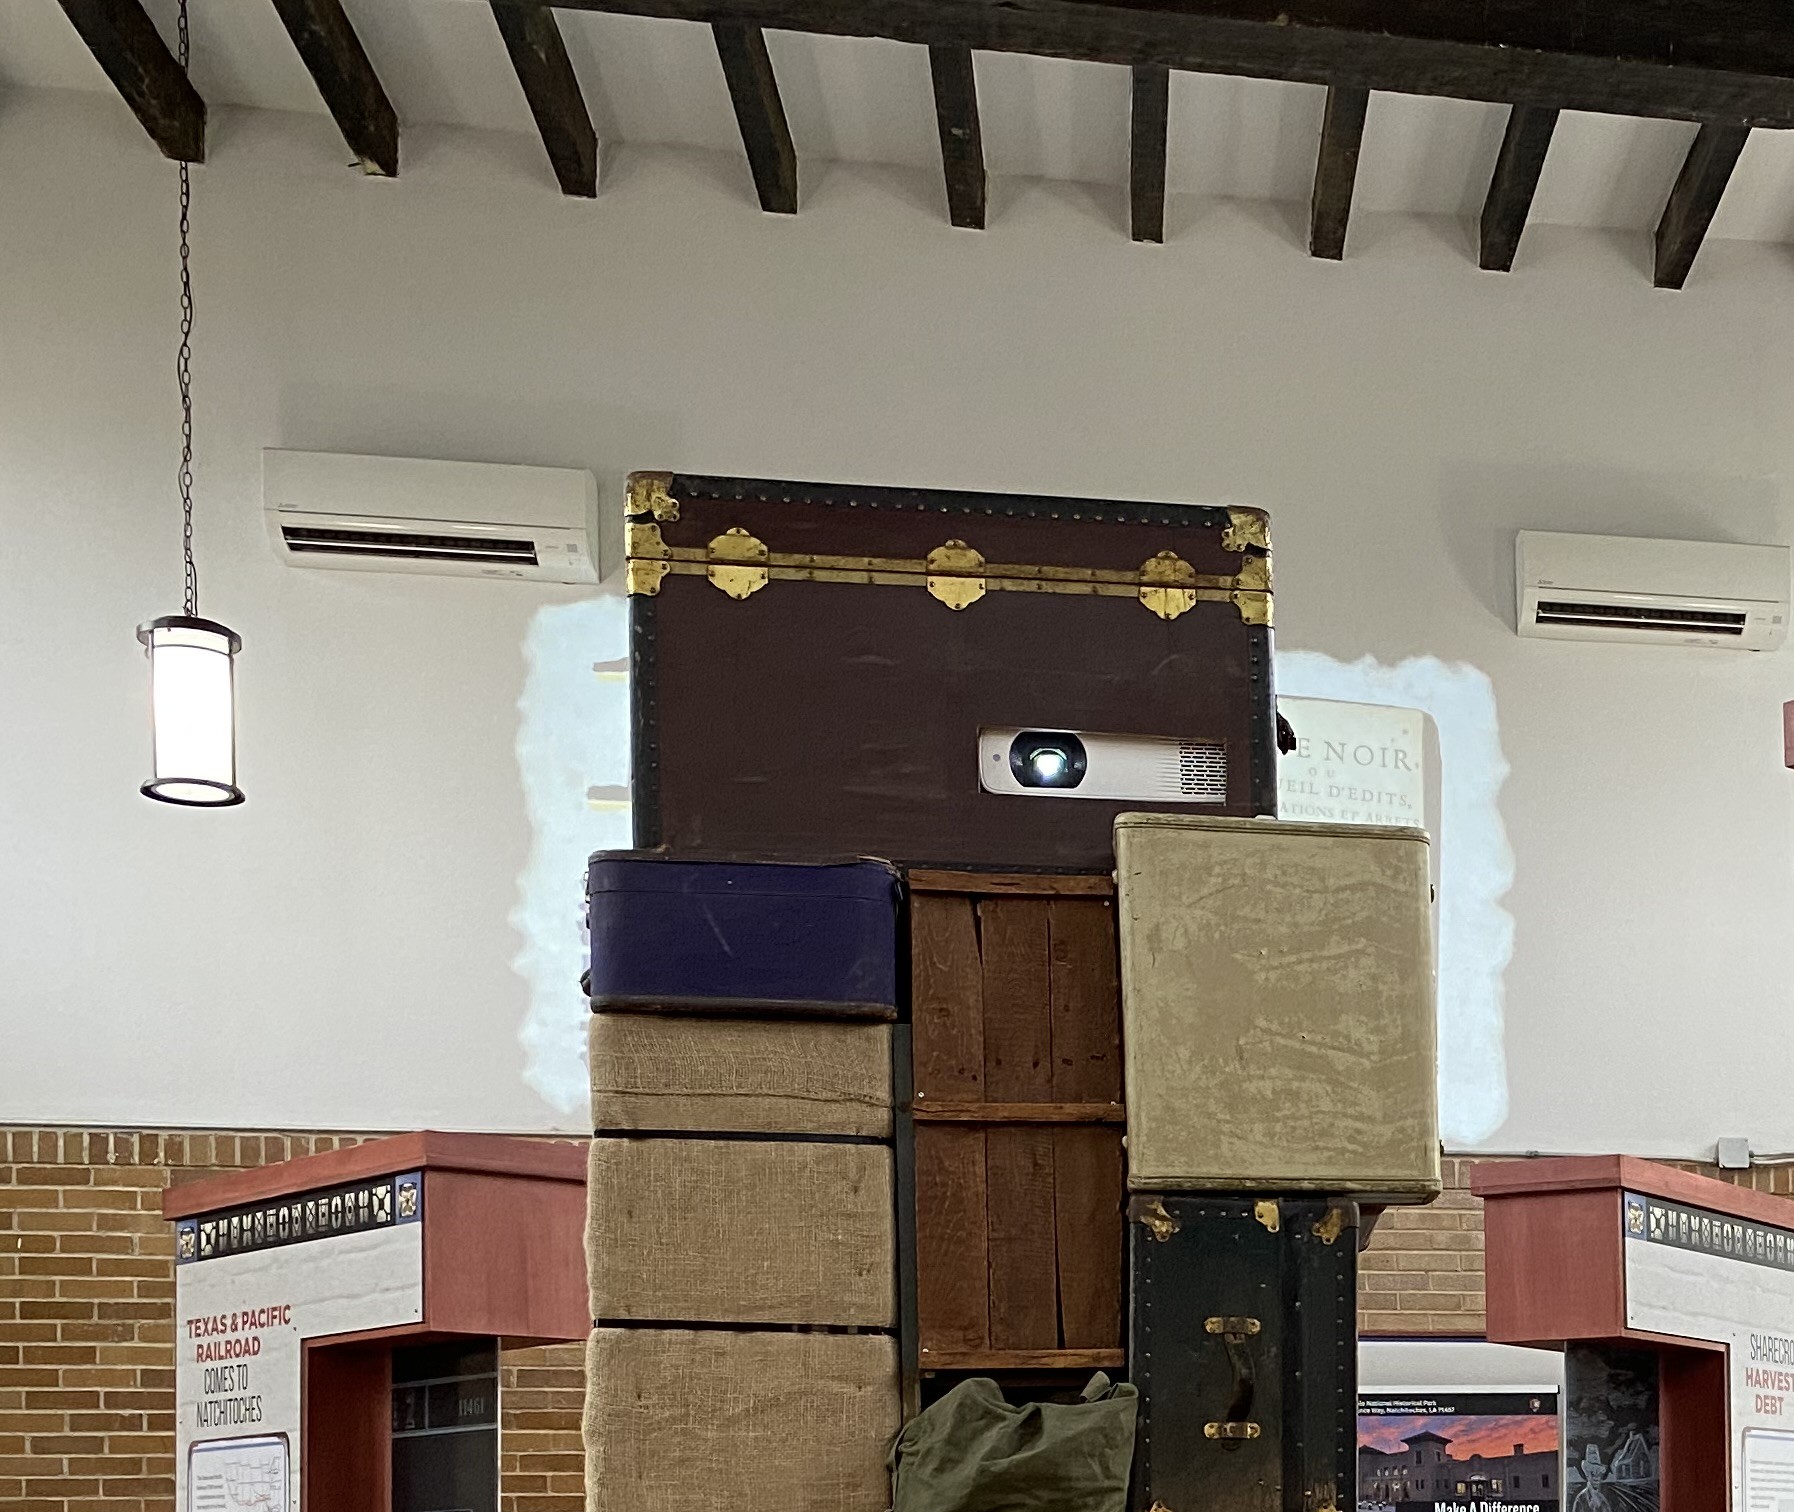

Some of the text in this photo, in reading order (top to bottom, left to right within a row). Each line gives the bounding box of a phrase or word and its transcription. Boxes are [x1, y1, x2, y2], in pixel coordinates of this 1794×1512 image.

[187, 1304, 292, 1339] TEXAS & PACIFIC
[196, 1336, 261, 1363] RAILROAD
[204, 1364, 249, 1395] COMES TO
[196, 1395, 263, 1428] NATCHITOCHES
[1755, 1392, 1784, 1417] DEBT
